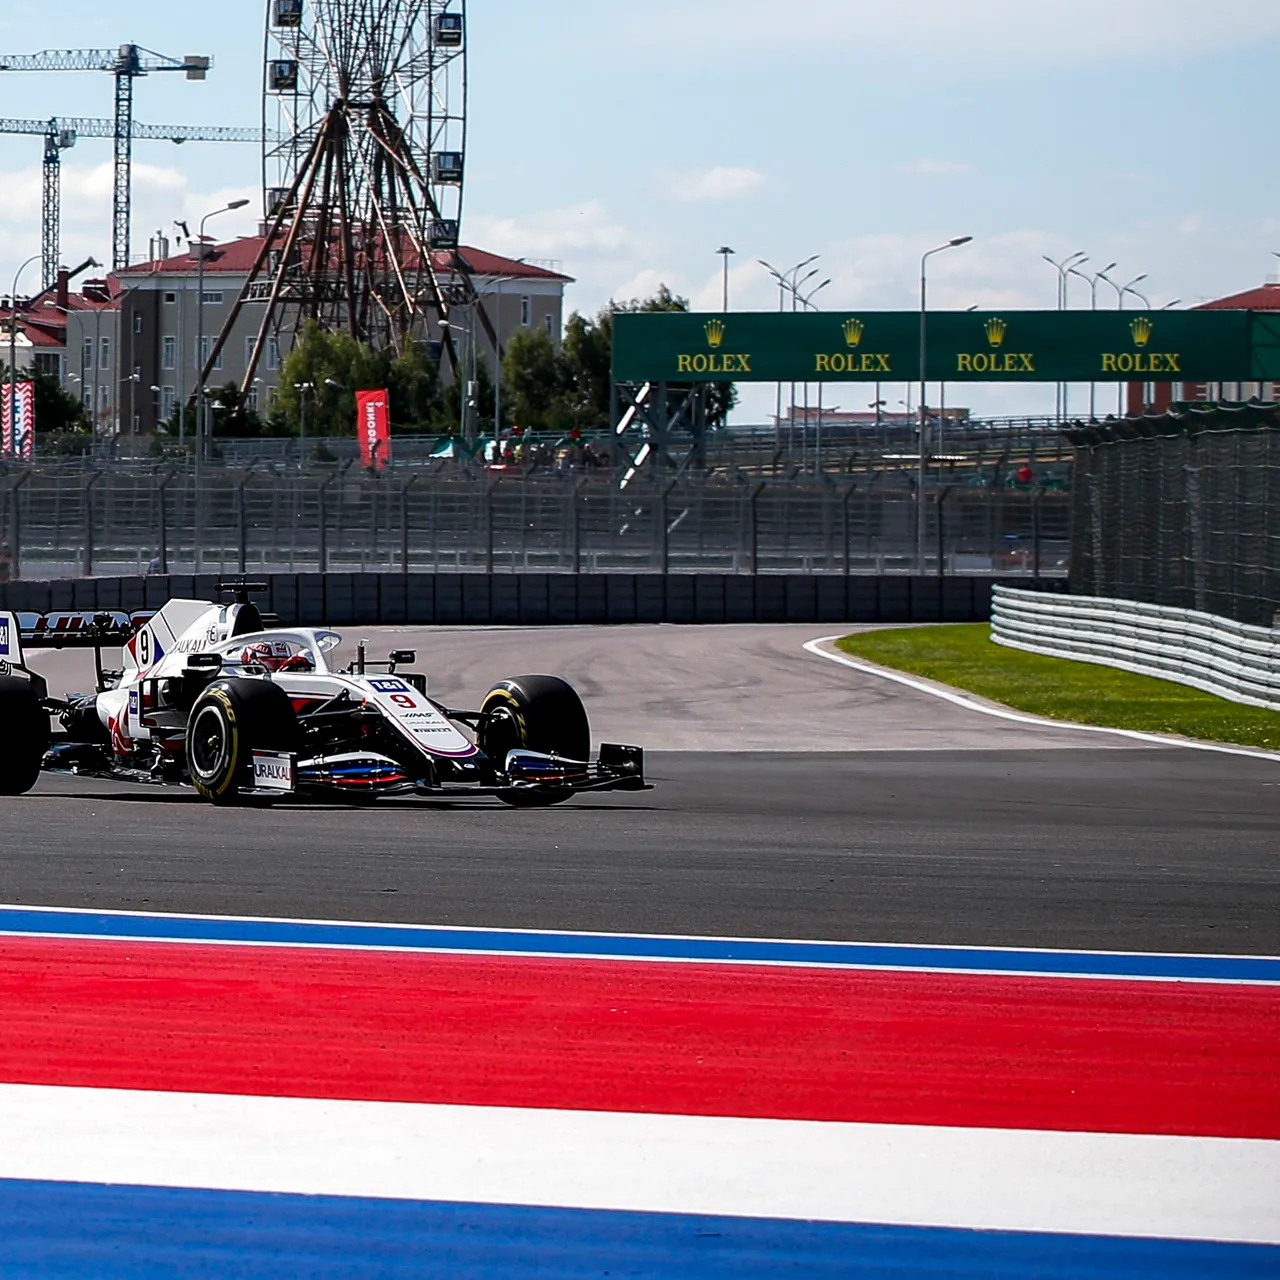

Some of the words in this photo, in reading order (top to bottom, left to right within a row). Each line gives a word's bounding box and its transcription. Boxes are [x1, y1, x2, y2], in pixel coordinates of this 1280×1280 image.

[678, 354, 751, 372] ROLEX
[816, 354, 890, 372] ROLEX
[958, 353, 1034, 371] ROLEX
[1102, 353, 1180, 372] ROLEX
[140, 629, 149, 665] 9
[371, 681, 405, 690] 1&1
[389, 694, 417, 709] 9
